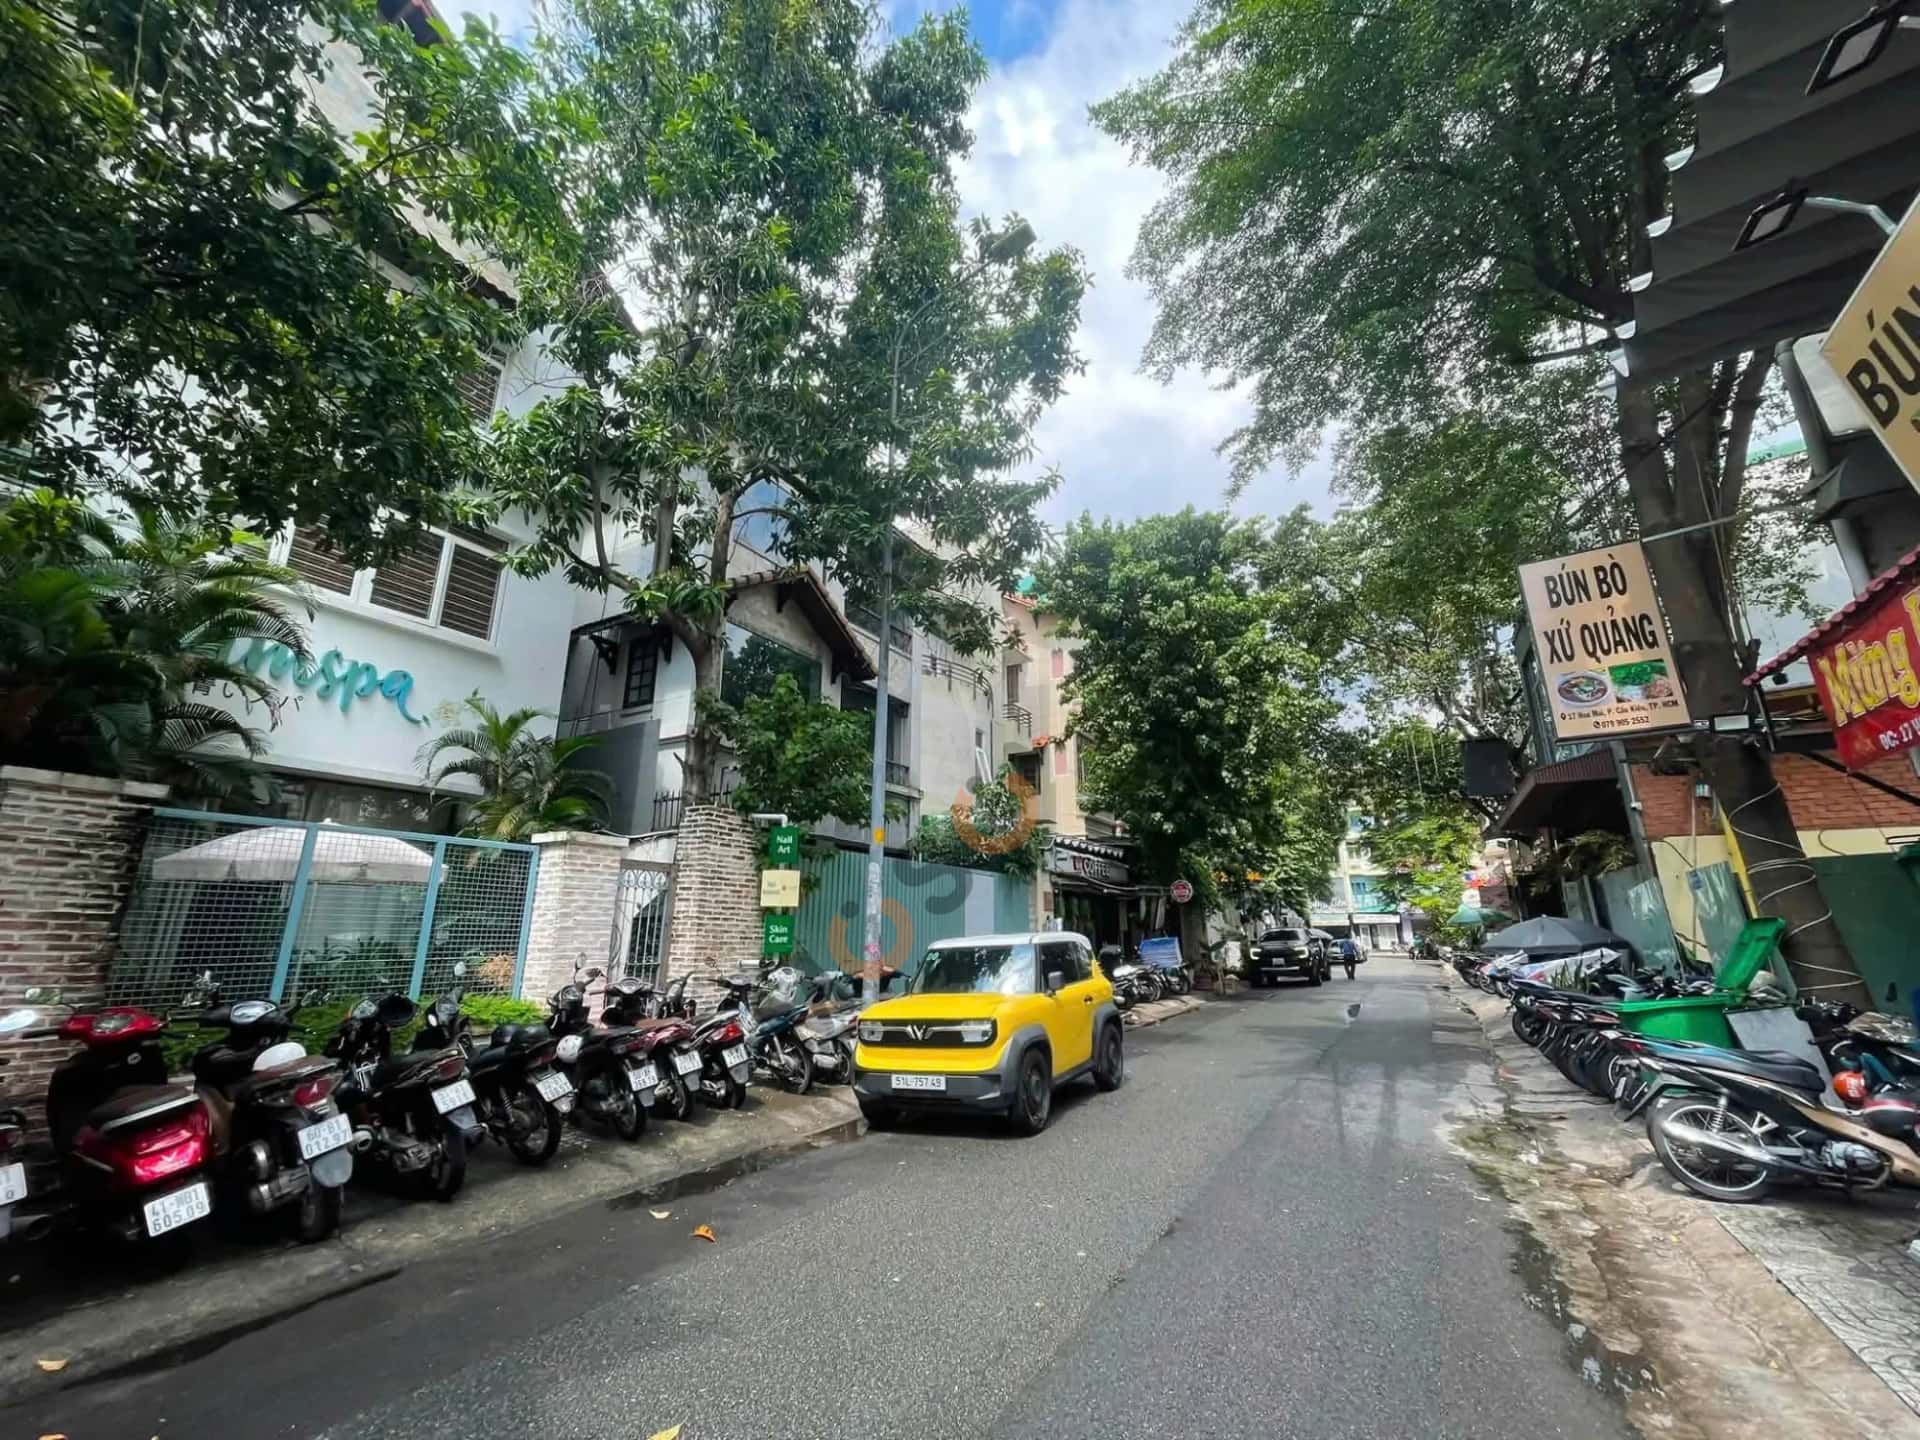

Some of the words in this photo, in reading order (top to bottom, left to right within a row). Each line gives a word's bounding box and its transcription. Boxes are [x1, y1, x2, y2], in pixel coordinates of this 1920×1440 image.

[1544, 563, 1592, 608] BÚN
[1594, 554, 1628, 599] BÒ
[1544, 617, 1575, 664] XỨ
[1580, 605, 1660, 664] QUẢNG
[776, 835, 793, 844] Nail
[777, 845, 791, 854] Art
[769, 925, 788, 934] Skin
[768, 935, 788, 944] Care
